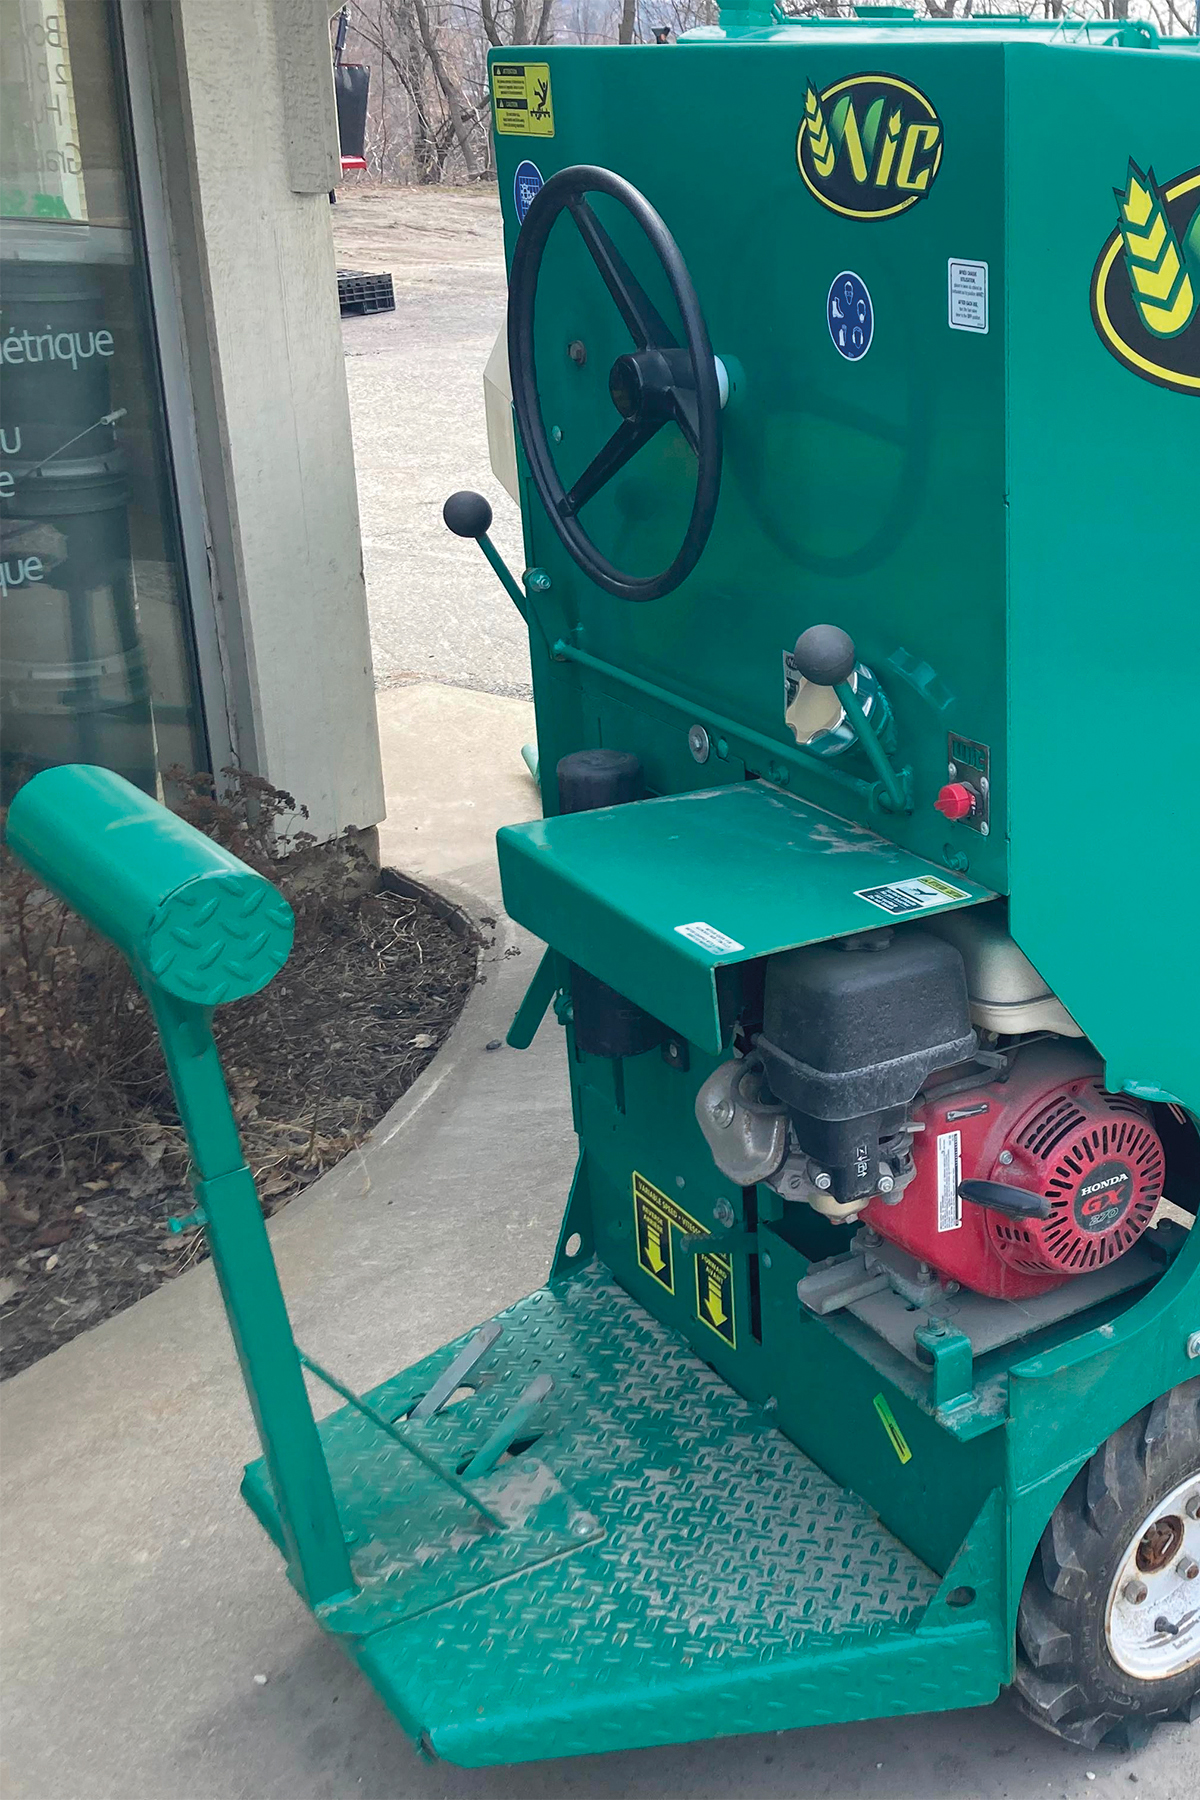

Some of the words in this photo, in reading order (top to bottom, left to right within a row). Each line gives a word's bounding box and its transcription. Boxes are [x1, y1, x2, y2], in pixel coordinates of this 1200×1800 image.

[0, 324, 115, 370] étrique
[1081, 1173, 1128, 1196] HONDA
[638, 1180, 662, 1206] VARIABLE
[661, 1201, 678, 1218] SPEED
[1081, 1184, 1127, 1216] GX
[1089, 1207, 1119, 1227] 270
[701, 1253, 727, 1279] FORWARD
[705, 1266, 724, 1285] AVANT
